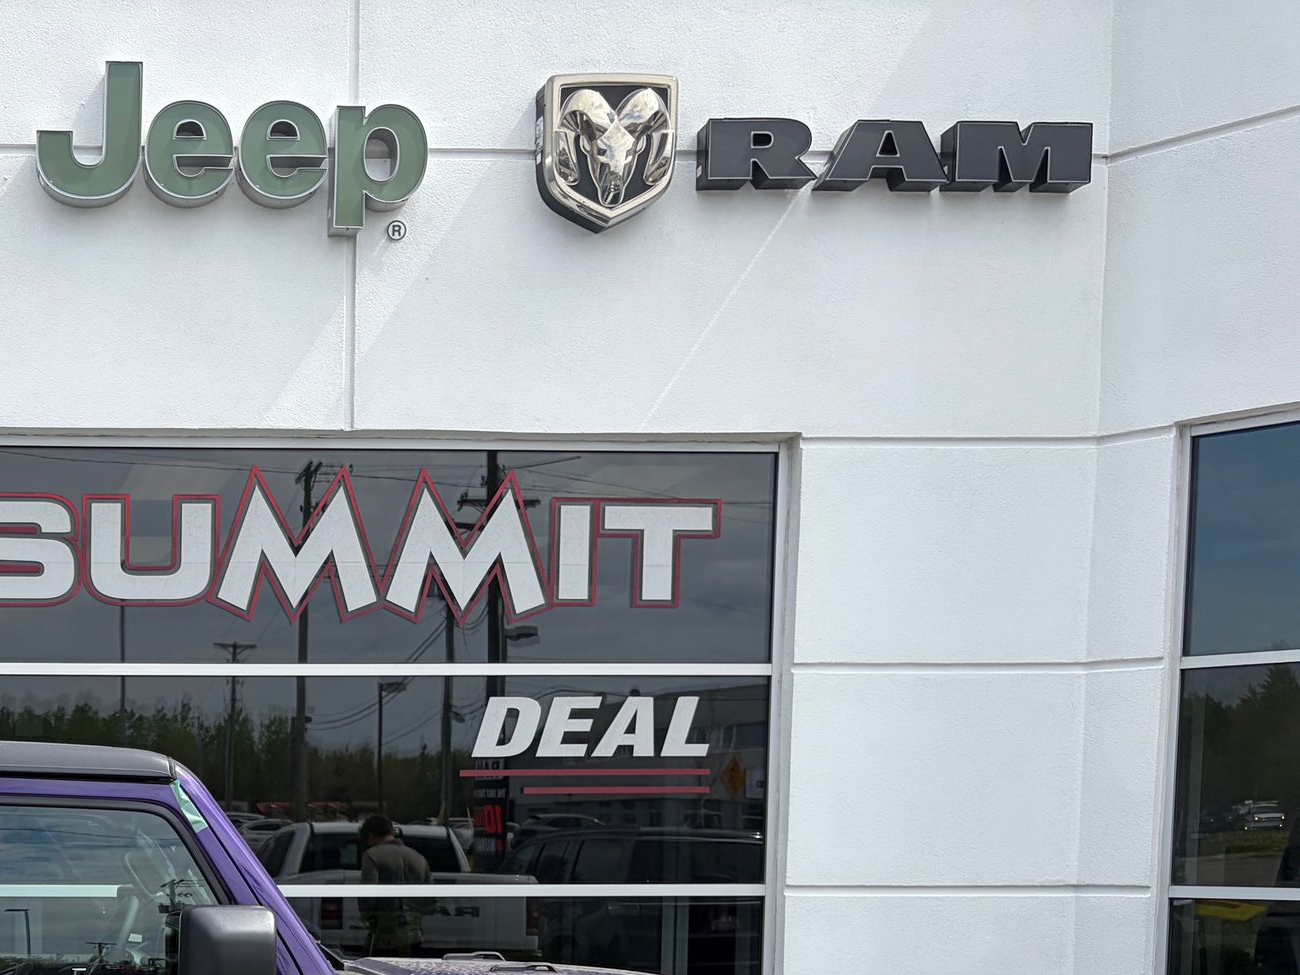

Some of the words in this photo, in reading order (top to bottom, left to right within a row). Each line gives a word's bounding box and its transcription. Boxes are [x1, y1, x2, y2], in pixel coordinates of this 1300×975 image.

[36, 60, 429, 237] Jeep
[697, 117, 1093, 192] RAM
[471, 695, 711, 758] DEAL
